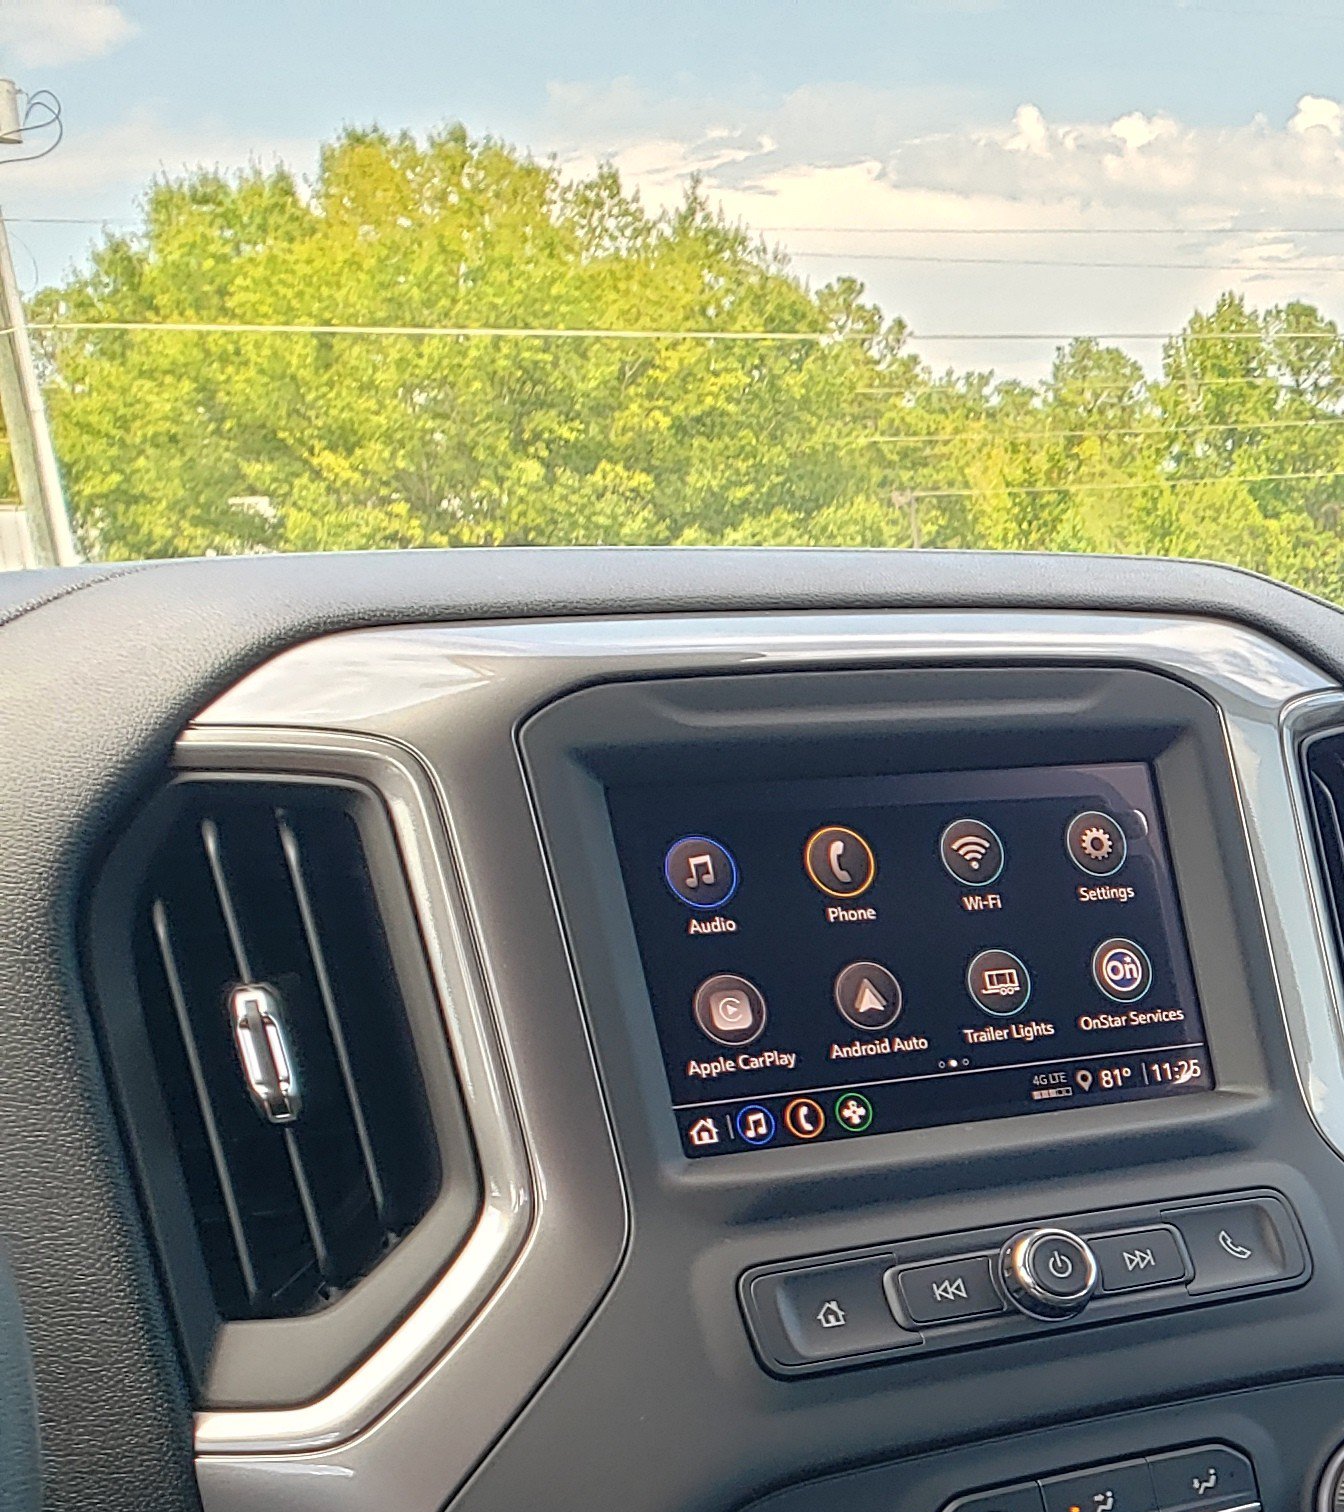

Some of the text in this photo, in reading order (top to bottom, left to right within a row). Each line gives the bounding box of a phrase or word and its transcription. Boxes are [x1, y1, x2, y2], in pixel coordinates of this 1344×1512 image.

[963, 894, 1002, 911] Wi-Fi
[1078, 886, 1135, 903] Settings
[827, 906, 877, 922] Phone
[688, 916, 737, 934] Audio
[1078, 1008, 1185, 1031] OnStar Services
[963, 1021, 1055, 1044] Trailer Lights
[830, 1034, 928, 1059] Android Auto
[687, 1050, 796, 1078] Apple CarPlay
[1032, 1072, 1068, 1086] 4G LTE
